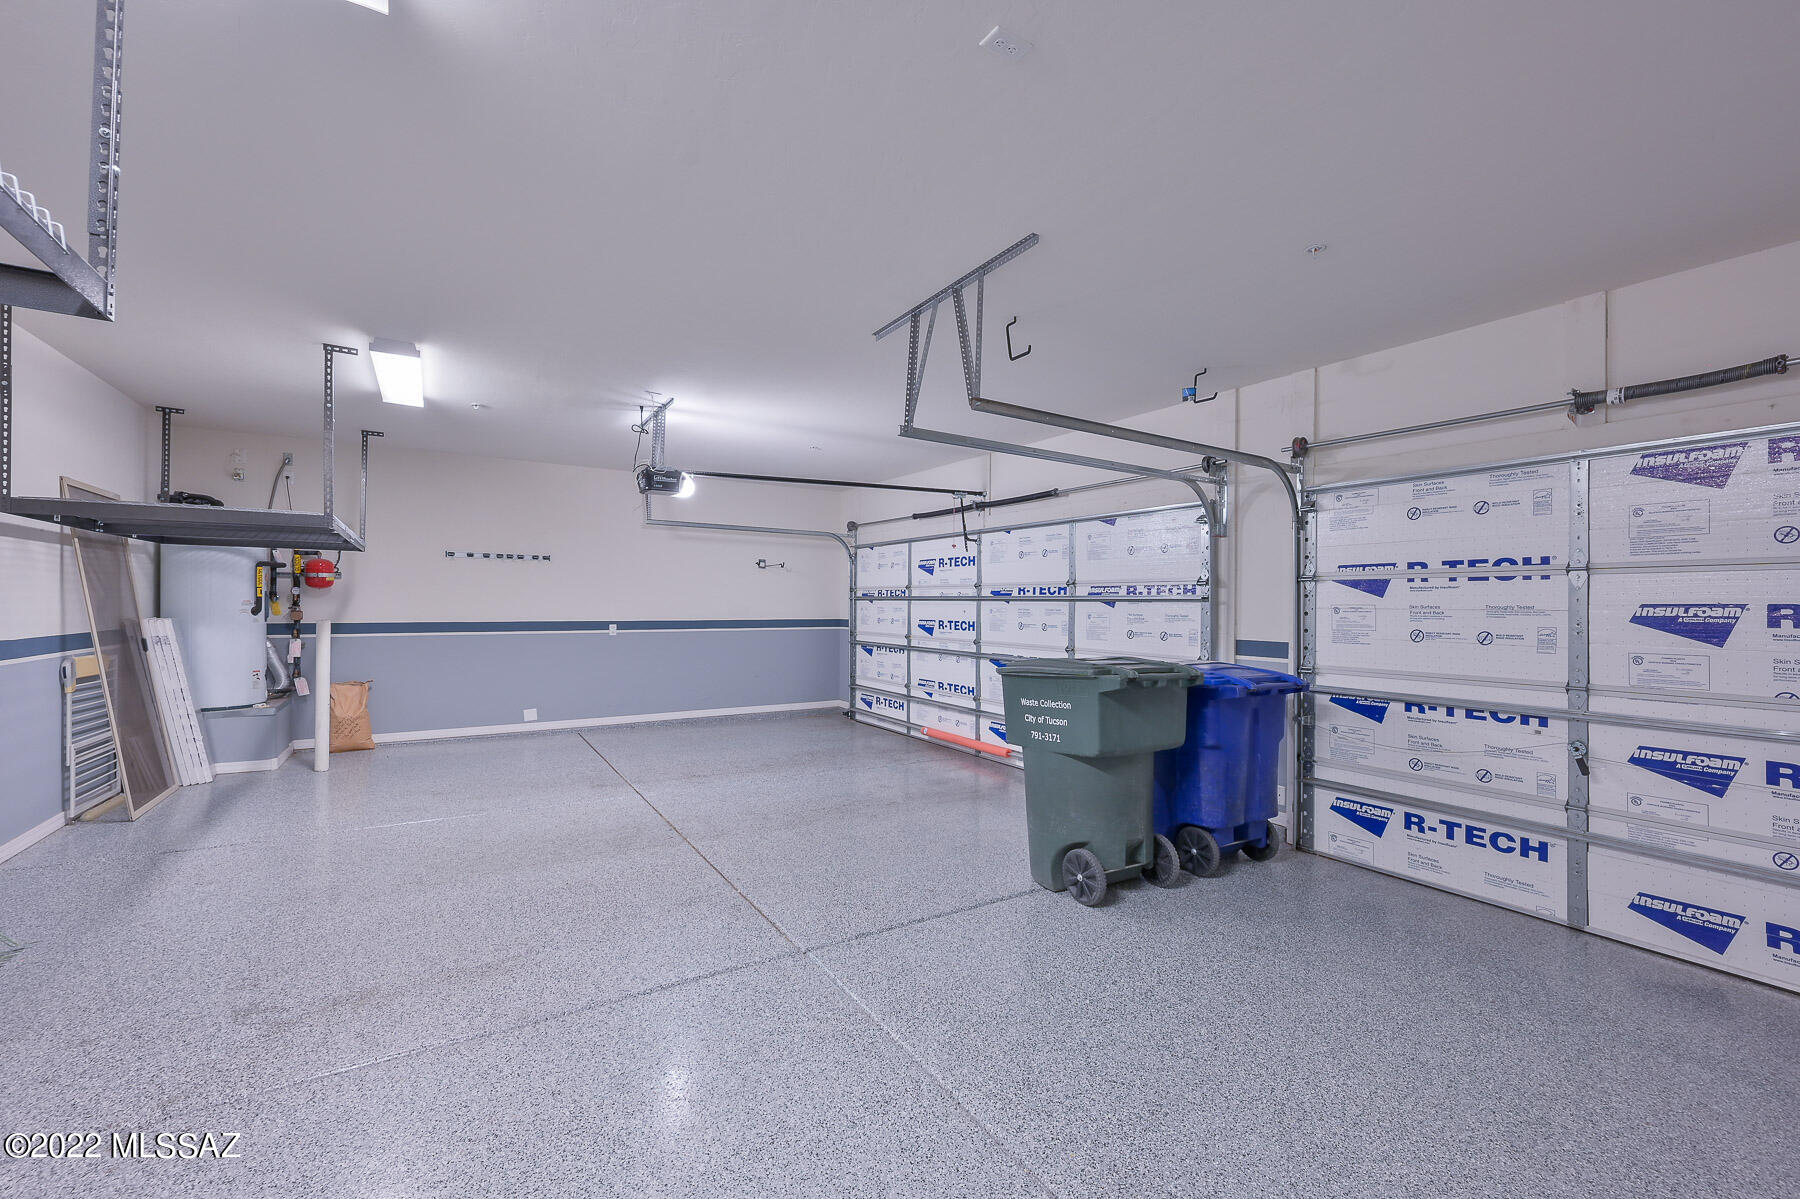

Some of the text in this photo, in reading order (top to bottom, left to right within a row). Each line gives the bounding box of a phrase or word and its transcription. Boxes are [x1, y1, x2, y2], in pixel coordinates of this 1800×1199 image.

[938, 555, 976, 568] R-TECH
[877, 589, 907, 597] R-TECH
[1126, 583, 1197, 596] R-TECH
[938, 620, 976, 632] R-TECH
[1773, 665, 1795, 673] Front
[937, 681, 975, 696] R-TECH
[875, 696, 905, 712] R-TECH
[1020, 697, 1072, 710] Waste Collection
[1024, 713, 1068, 727] City of Tucson
[1030, 730, 1061, 743] 791-3171
[1704, 767, 1736, 777] Company
[1772, 814, 1791, 823] Skin
[1772, 822, 1795, 831] Front
[1404, 811, 1549, 863] R-TECH
[1704, 920, 1736, 935] Company
